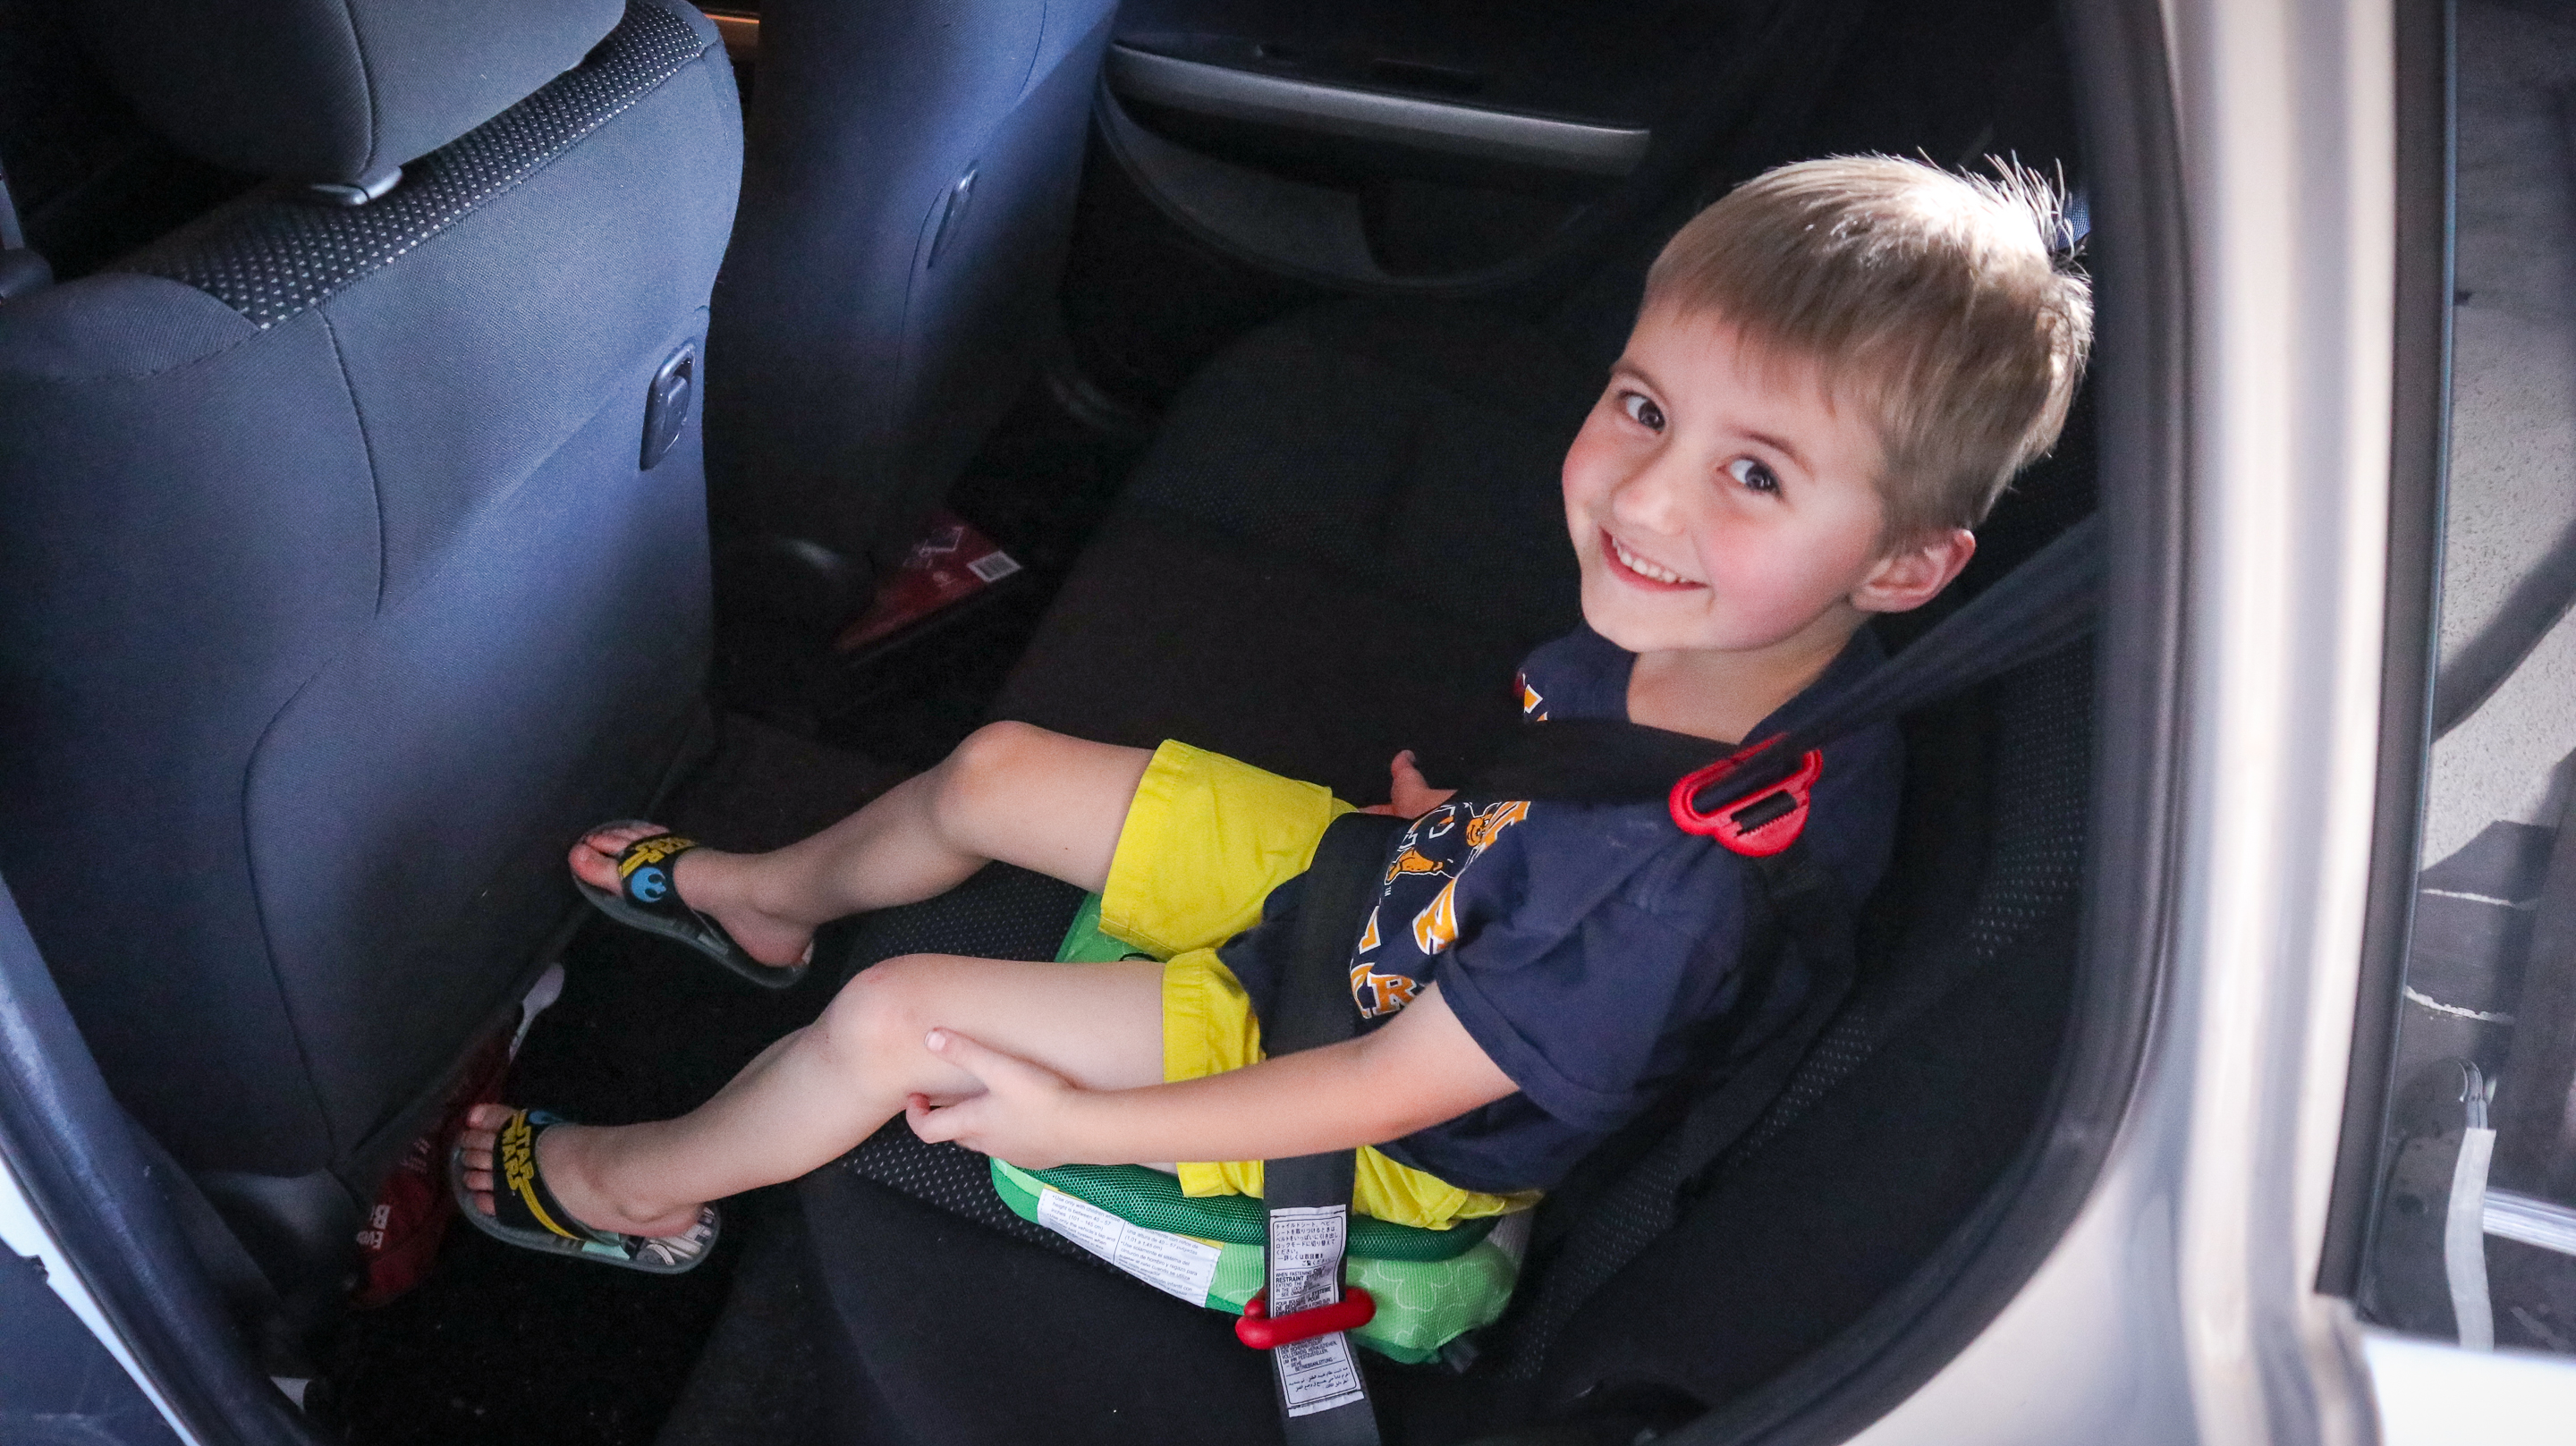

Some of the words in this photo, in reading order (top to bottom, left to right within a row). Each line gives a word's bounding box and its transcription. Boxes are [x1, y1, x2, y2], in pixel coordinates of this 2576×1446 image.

[1053, 1202, 1067, 1210] height
[1073, 1209, 1092, 1220] between
[1086, 1206, 1104, 1216] children
[1105, 1213, 1120, 1222] whose
[1133, 1245, 1157, 1256] solamente
[1163, 1255, 1181, 1264] sistema
[1147, 1256, 1165, 1265] hombro
